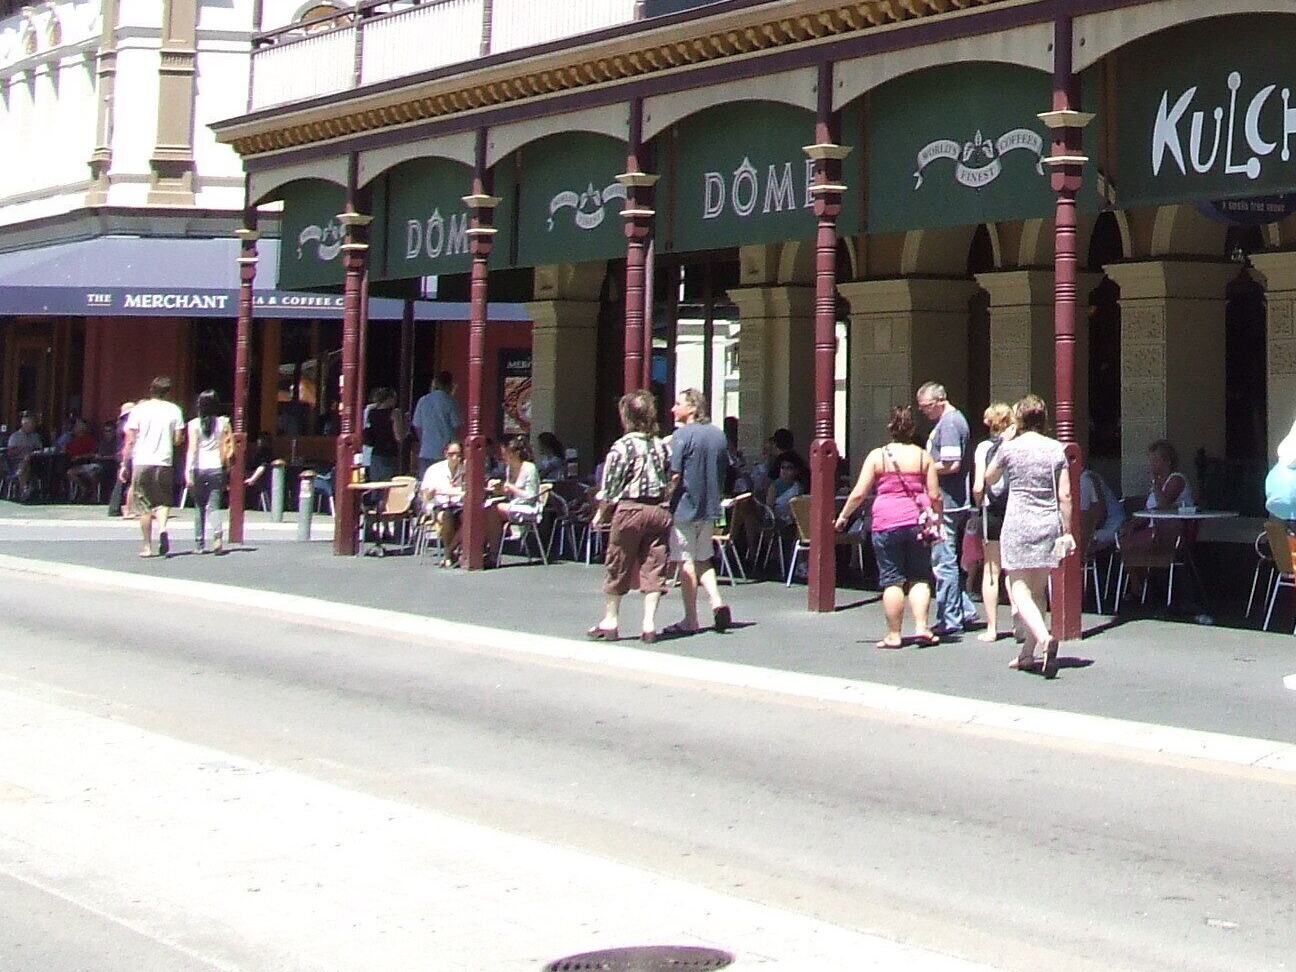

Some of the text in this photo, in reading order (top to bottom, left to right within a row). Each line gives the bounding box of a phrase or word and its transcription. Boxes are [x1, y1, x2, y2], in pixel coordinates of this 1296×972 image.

[87, 293, 112, 303] THE
[123, 293, 228, 309] MERCHANT
[281, 296, 331, 307] COFFEE
